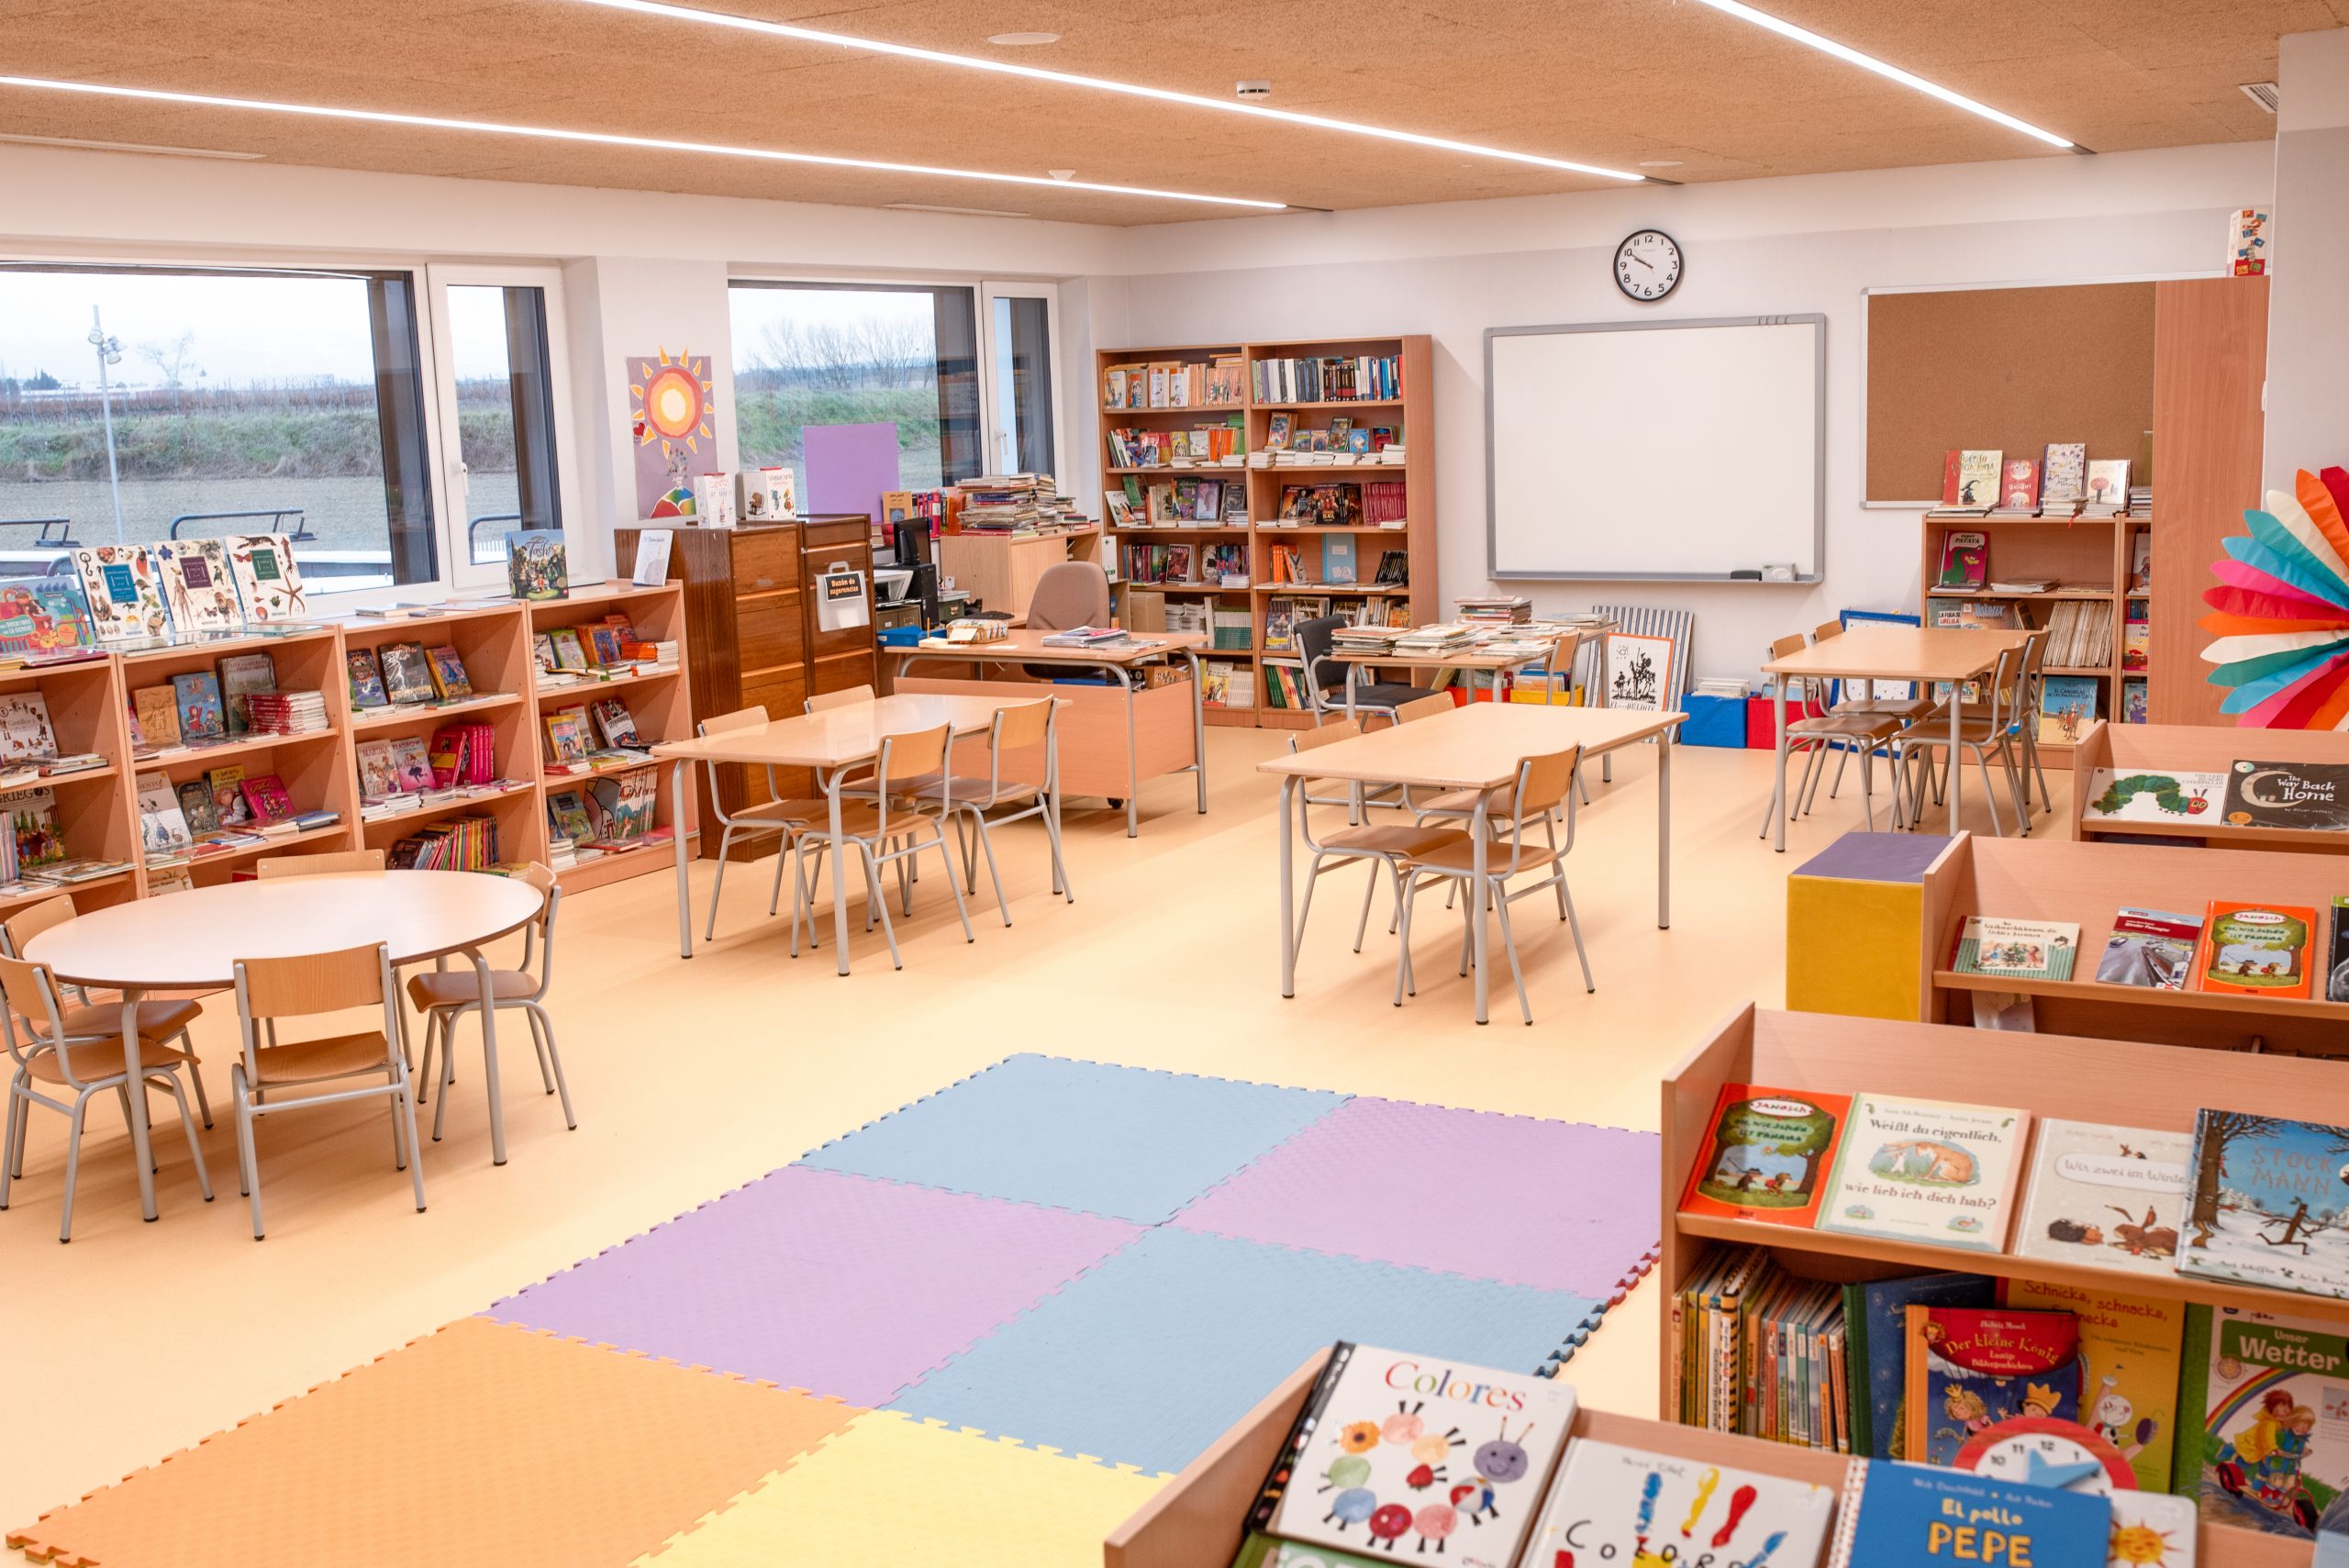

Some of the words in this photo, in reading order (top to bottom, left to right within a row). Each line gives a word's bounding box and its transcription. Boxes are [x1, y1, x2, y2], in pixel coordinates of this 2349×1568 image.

[1633, 239, 1640, 247] 11
[1644, 235, 1653, 243] 12
[1624, 249, 1632, 257] 10
[1667, 248, 1675, 256] 2
[1620, 261, 1627, 271] 9
[1671, 261, 1678, 269] 3
[1623, 273, 1631, 284] 8
[1666, 273, 1674, 282] 4
[1633, 284, 1640, 293] 7
[1643, 287, 1653, 296] 6
[1658, 284, 1664, 293] 5
[829, 585, 859, 595] sugerencias
[2277, 778, 2299, 788] Way
[2302, 781, 2336, 792] Back
[2283, 787, 2334, 801] Home
[1869, 1118, 1909, 1132] Weißt
[1912, 1125, 1930, 1135] du
[2252, 1146, 2334, 1173] STOCK
[2065, 1159, 2089, 1173] Wir
[2093, 1166, 2123, 1176] zwei
[2128, 1170, 2143, 1179] im
[2147, 1170, 2187, 1184] Winte
[2252, 1167, 2332, 1195] MANN
[1844, 1182, 1869, 1193] wie
[1873, 1184, 1898, 1196] lieb
[1900, 1188, 1922, 1200] ich
[1926, 1191, 1956, 1205] dich
[1959, 1195, 1997, 1210] hab?
[2023, 1280, 2091, 1305] Schnicke,
[2097, 1298, 2168, 1322] schnacke,
[2274, 1329, 2310, 1344] Unser
[1945, 1340, 1972, 1355] Der
[1974, 1333, 2015, 1348] kleine
[2019, 1337, 2060, 1365] König
[2239, 1335, 2342, 1371] Wetter
[1384, 1360, 1527, 1412] Colores
[2012, 1443, 2025, 1455] 11
[2040, 1440, 2055, 1452] 12
[1991, 1454, 2006, 1466] 10
[1942, 1497, 1965, 1518] El
[1969, 1507, 2023, 1527] pollo
[1928, 1520, 2033, 1568] PEPE
